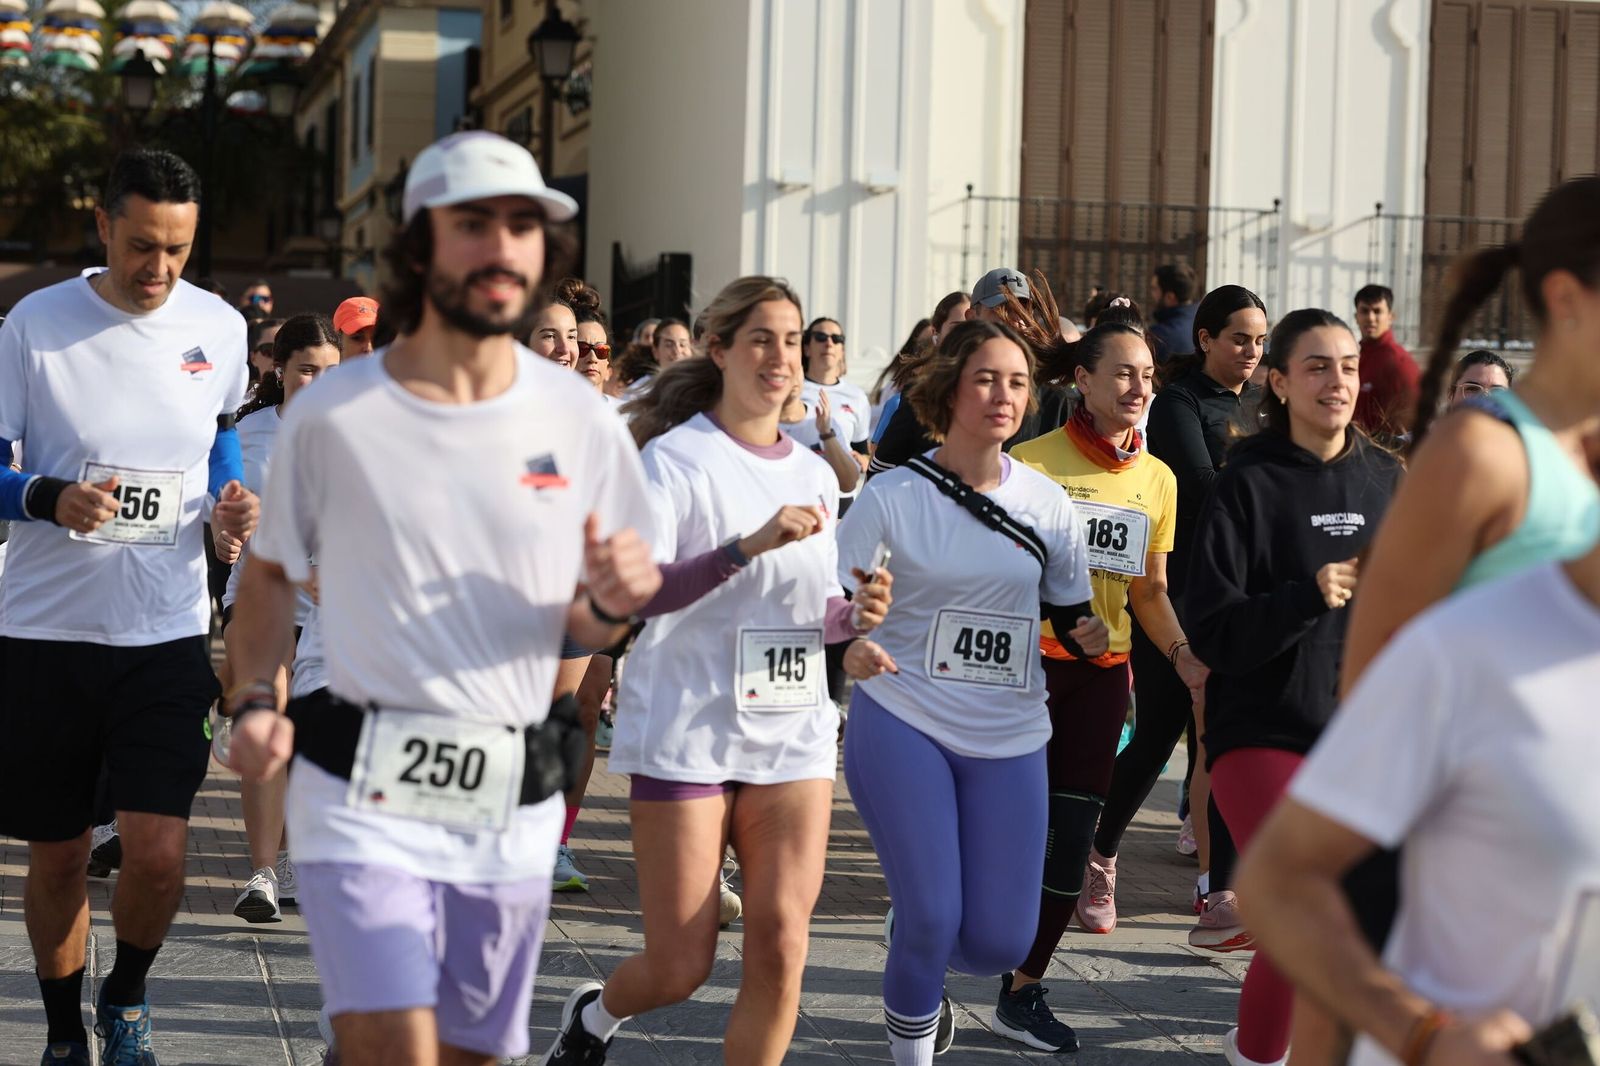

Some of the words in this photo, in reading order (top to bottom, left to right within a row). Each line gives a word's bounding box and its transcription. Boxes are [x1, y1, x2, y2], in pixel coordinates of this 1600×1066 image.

[1087, 517, 1128, 551] 183
[953, 626, 1012, 665] 498
[764, 647, 806, 682] 145
[399, 737, 487, 791] 250
